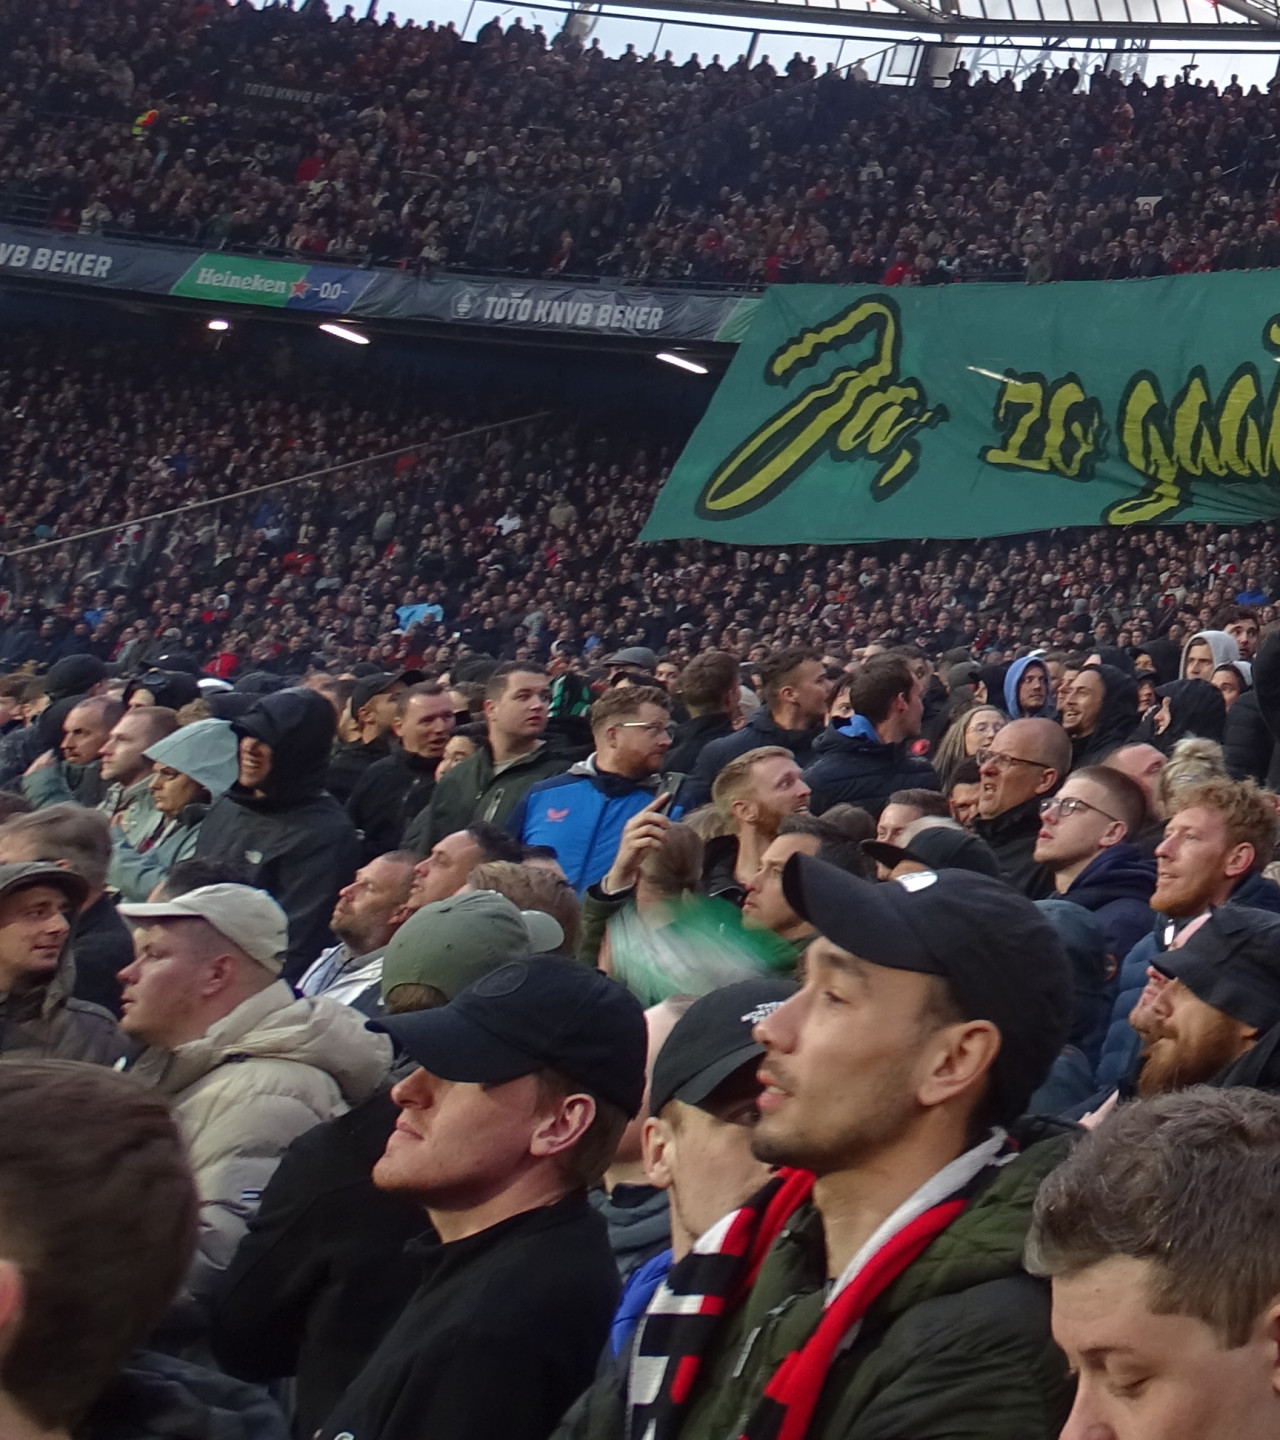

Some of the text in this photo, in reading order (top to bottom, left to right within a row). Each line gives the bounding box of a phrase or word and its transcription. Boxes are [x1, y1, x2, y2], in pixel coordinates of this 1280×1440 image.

[31, 248, 113, 278] BEKER
[195, 267, 286, 294] Heineken
[483, 294, 664, 330] TOTO KNVB BEKER
[697, 293, 949, 520] Ja,
